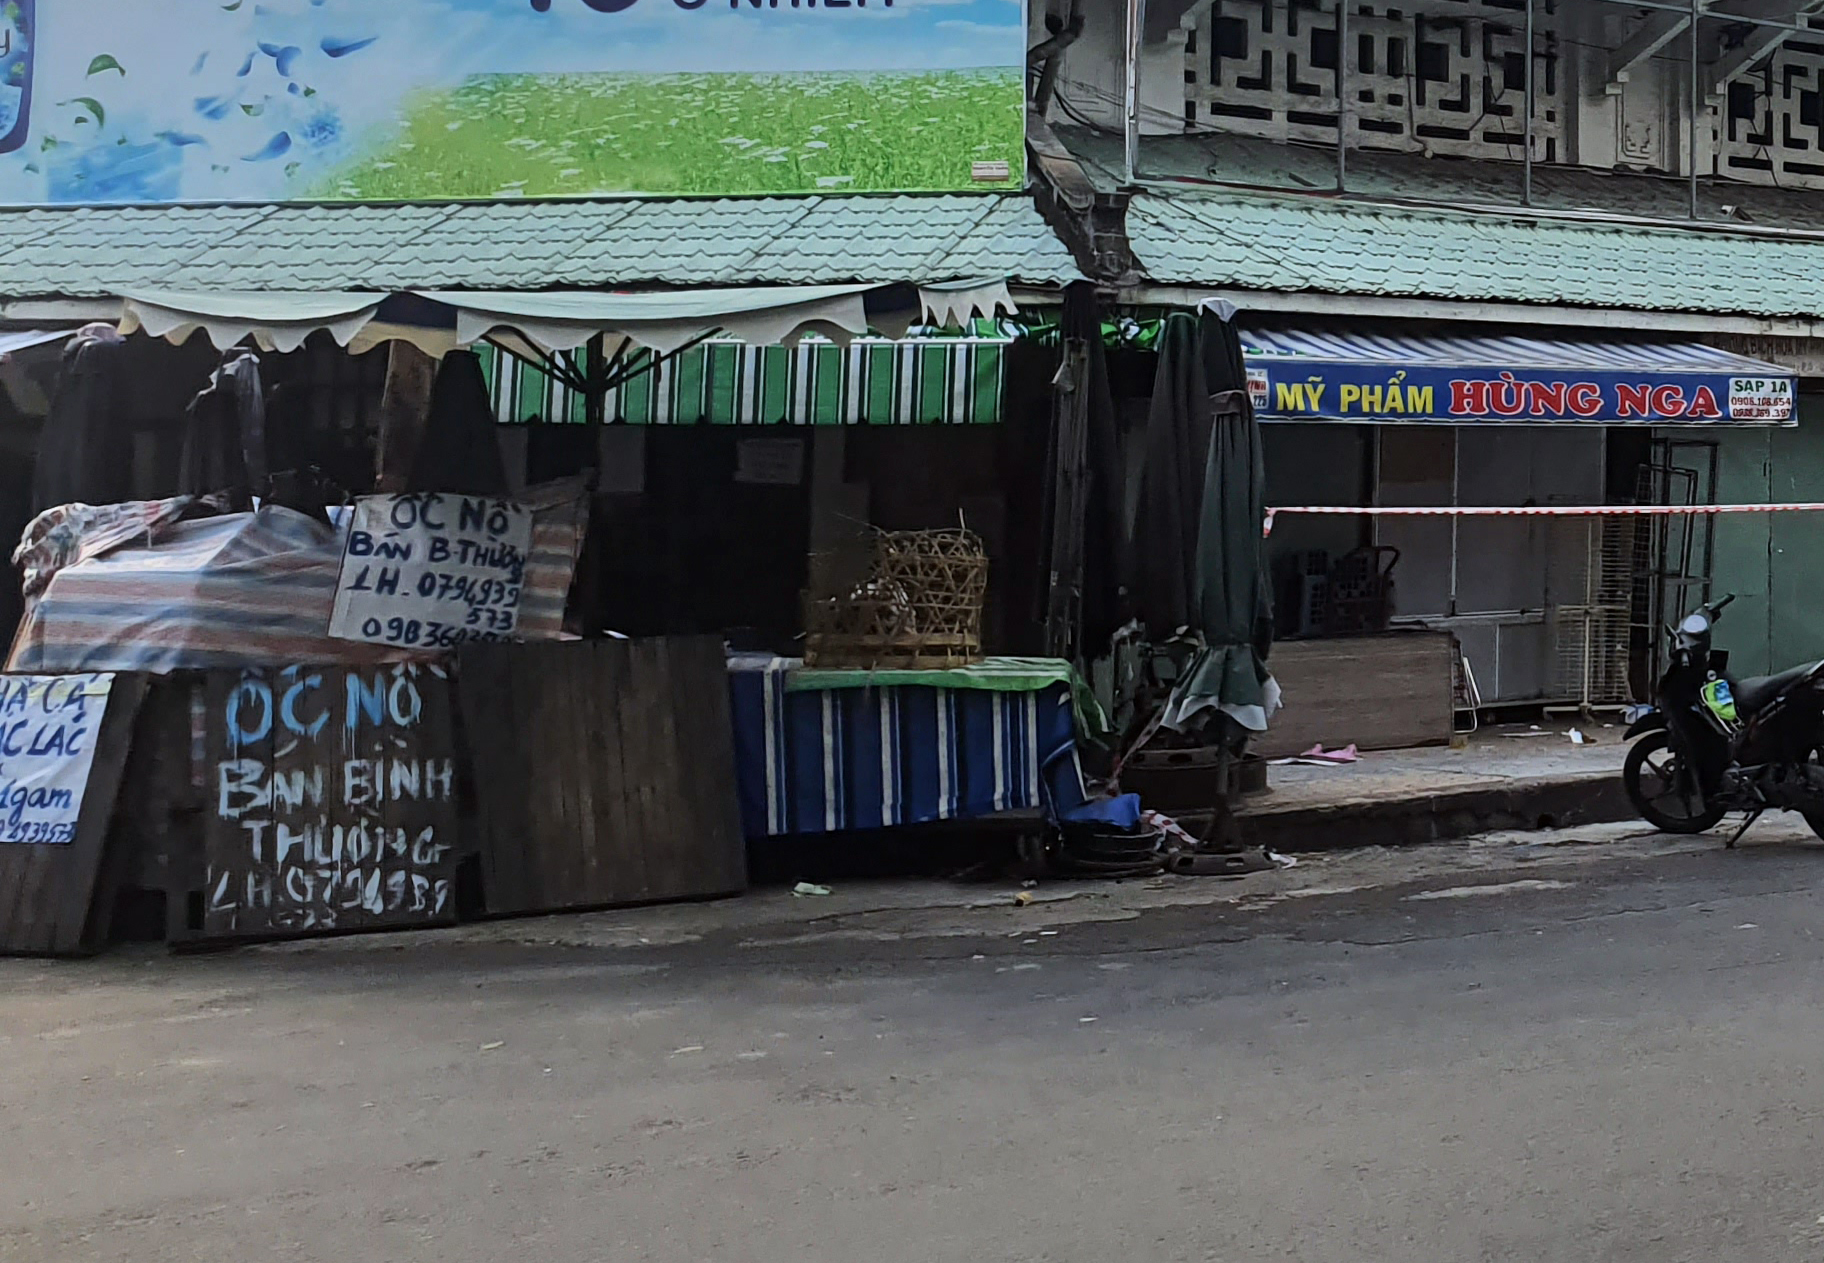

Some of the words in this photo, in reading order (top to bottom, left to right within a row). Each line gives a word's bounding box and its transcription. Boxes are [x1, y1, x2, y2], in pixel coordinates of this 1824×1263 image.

[1275, 376, 1325, 411] MỸ
[1340, 370, 1433, 414] PHẨM
[1449, 372, 1603, 416] HÙNG
[1615, 384, 1722, 418] NGA
[1771, 381, 1787, 393] 1A
[349, 531, 412, 561] BÁN
